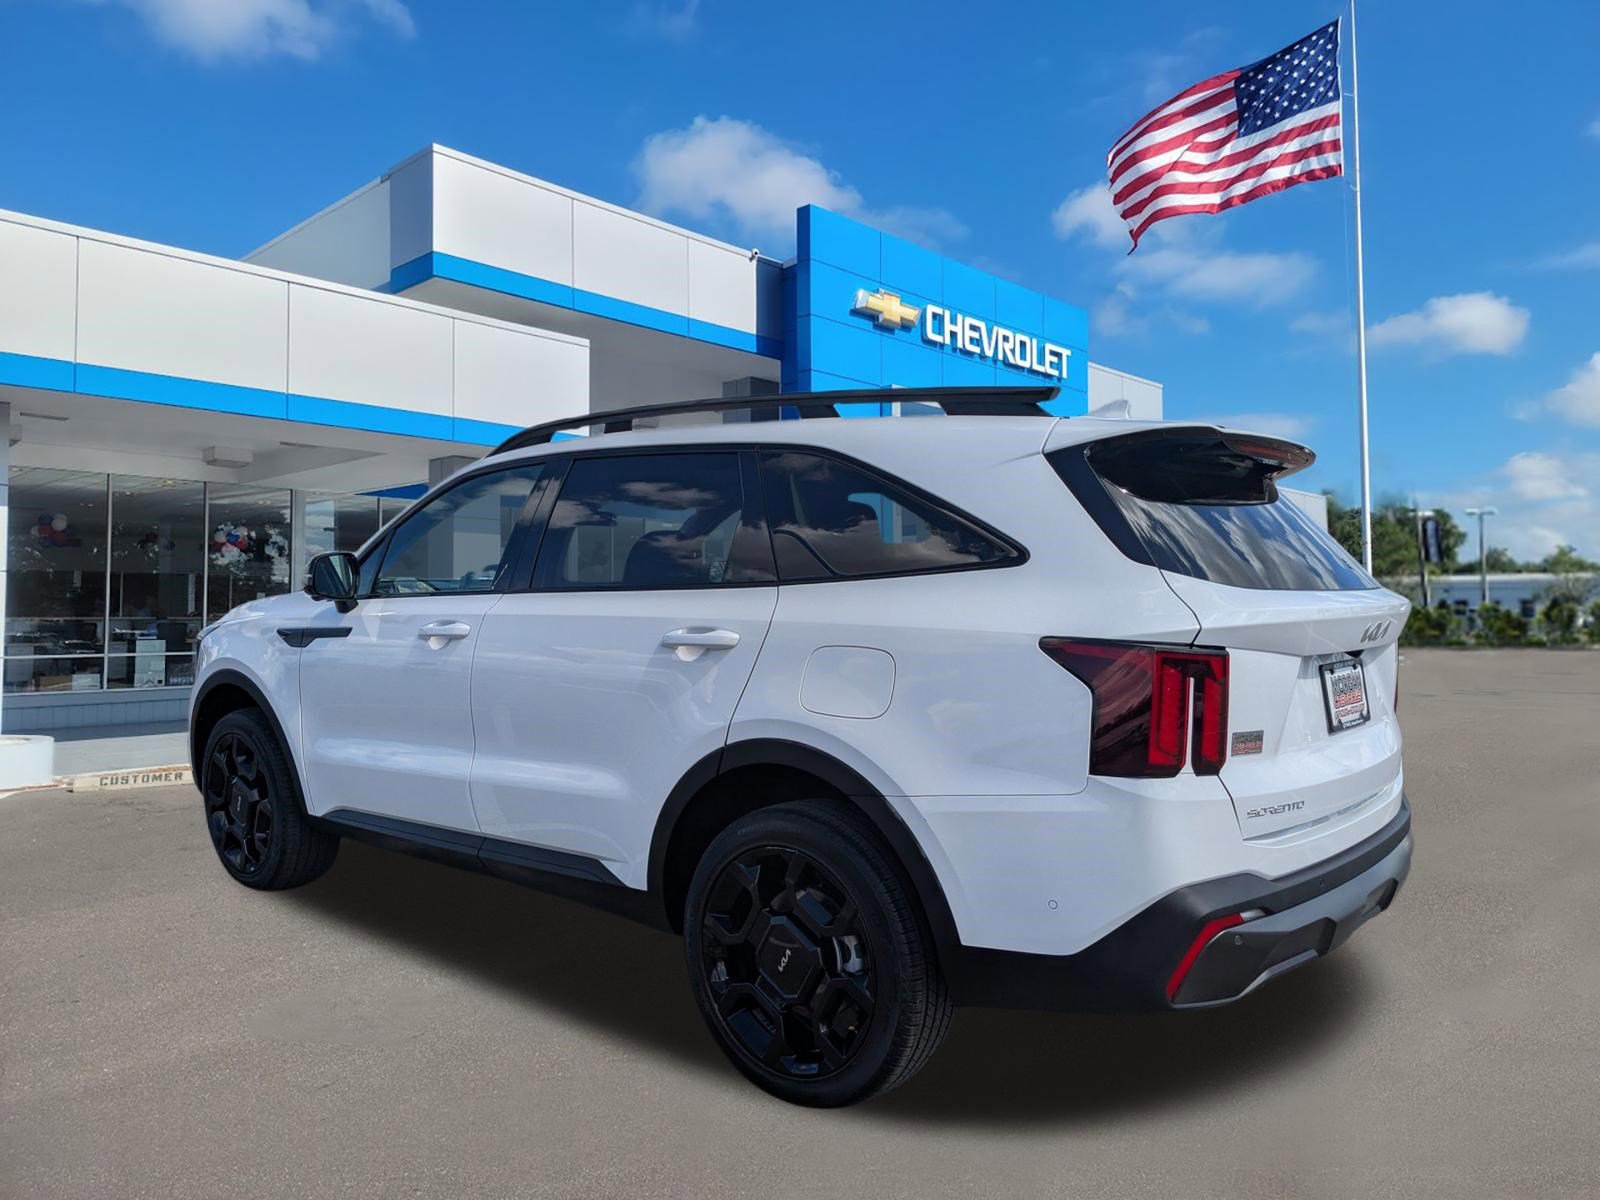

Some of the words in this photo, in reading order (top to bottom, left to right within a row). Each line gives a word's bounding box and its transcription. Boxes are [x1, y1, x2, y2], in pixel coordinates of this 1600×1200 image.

[925, 304, 1072, 379] CHEVROLET
[99, 771, 184, 787] CUSTOMER
[1246, 800, 1305, 819] SORENTO
